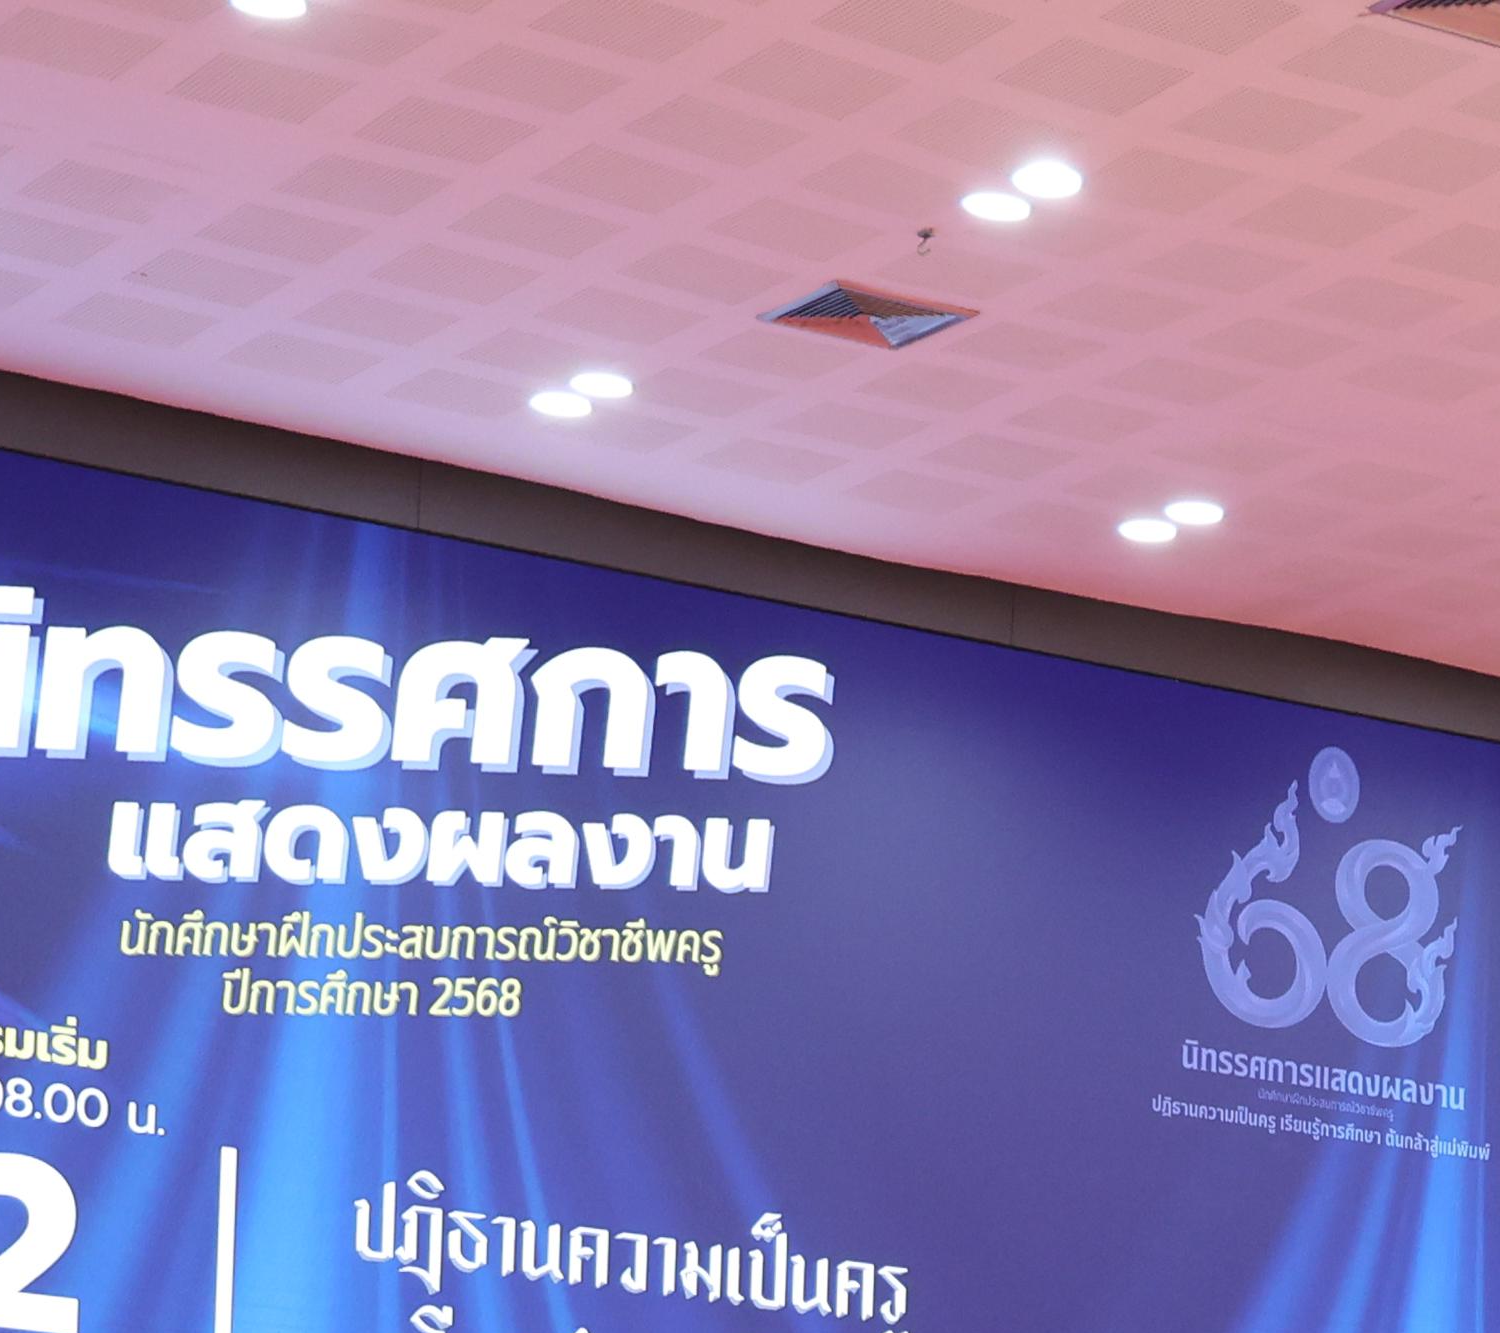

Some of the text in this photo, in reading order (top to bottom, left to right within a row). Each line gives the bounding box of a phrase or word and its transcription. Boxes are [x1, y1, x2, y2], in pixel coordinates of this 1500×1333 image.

[107, 798, 776, 893] แสดงผลงาน
[120, 908, 724, 977] นักศึกษาฝึกประสบการณ์วิชาชีพครู
[222, 968, 522, 1018] ปีการศึกษา 2568
[1181, 1039, 1466, 1111] นิทรรศการแสดงผลงาน
[127, 1096, 167, 1138] น.
